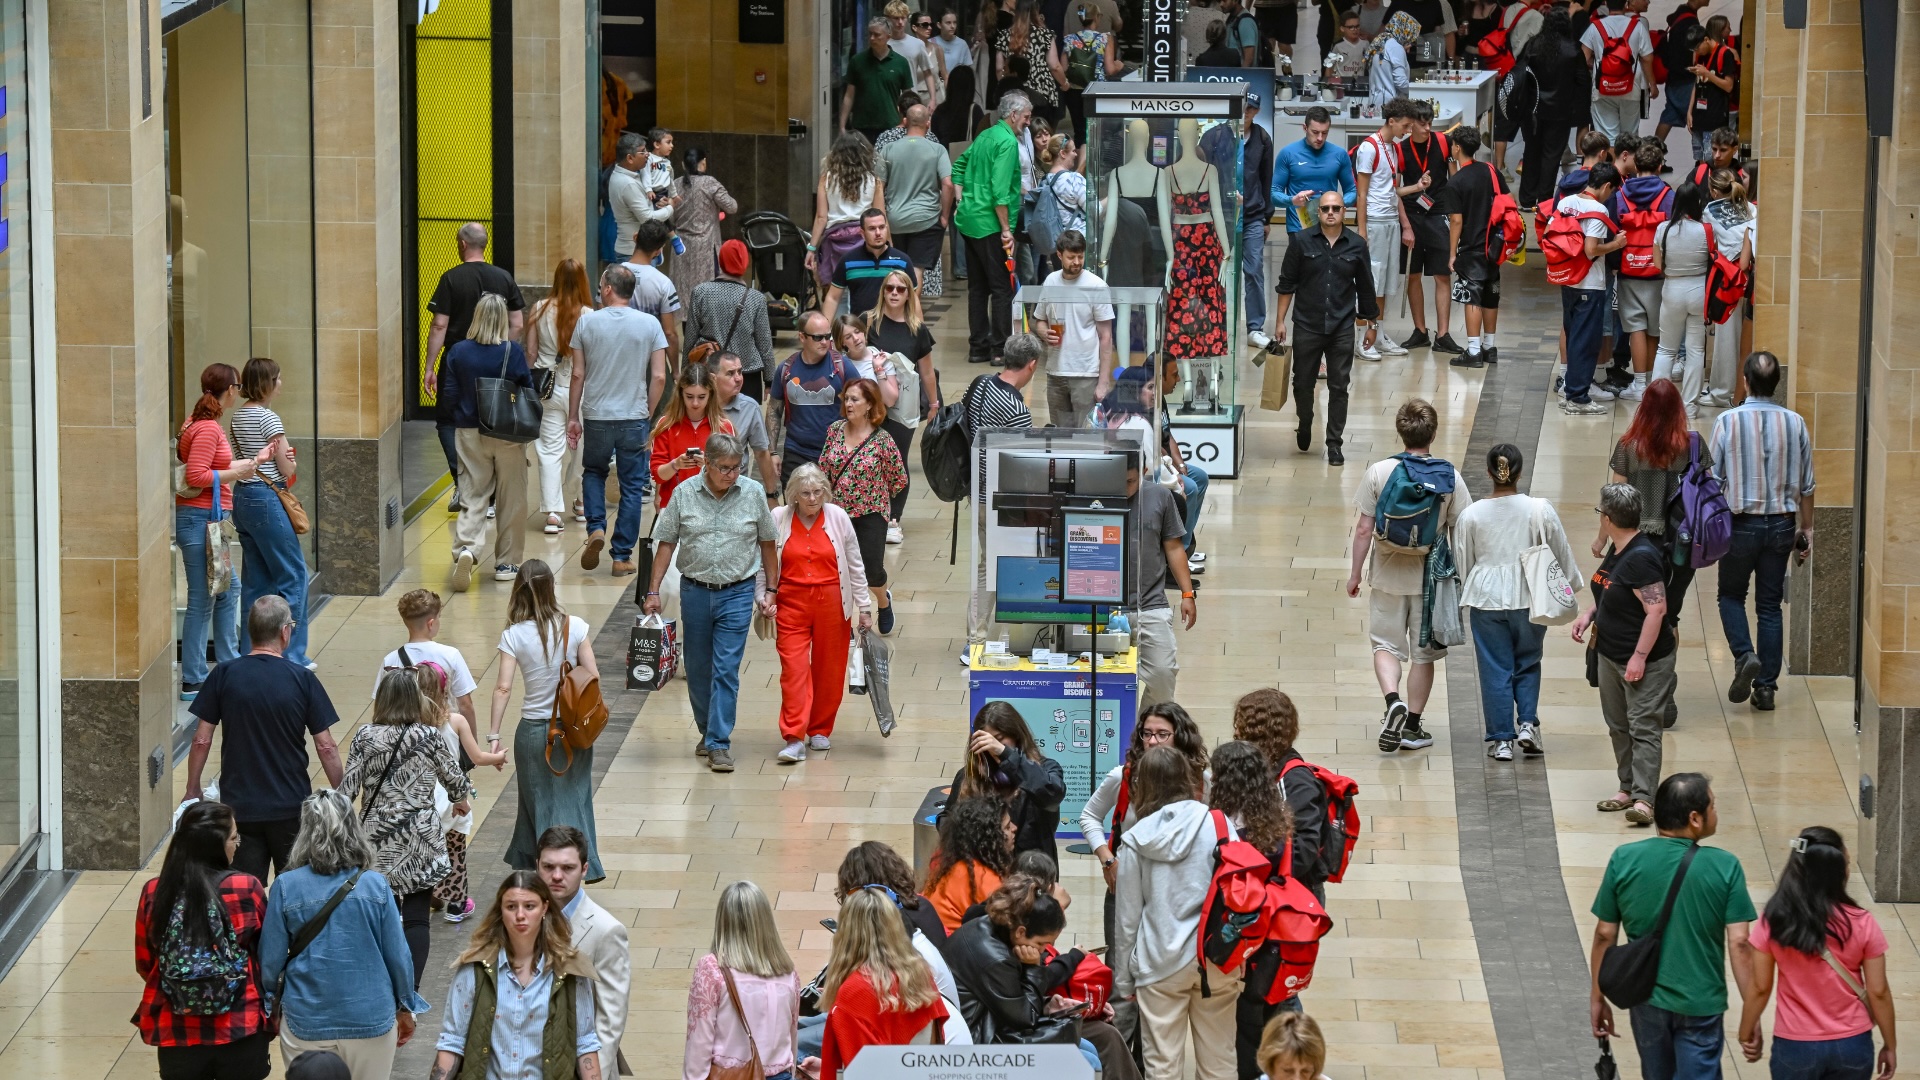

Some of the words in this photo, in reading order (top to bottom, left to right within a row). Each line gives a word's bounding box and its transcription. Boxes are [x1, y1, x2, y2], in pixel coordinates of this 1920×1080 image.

[1131, 100, 1194, 111] MANGO
[634, 638, 657, 649] M&S
[1063, 681, 1085, 689] GRAND
[901, 1052, 965, 1067] GRAND
[967, 1052, 1036, 1067] ARCADE
